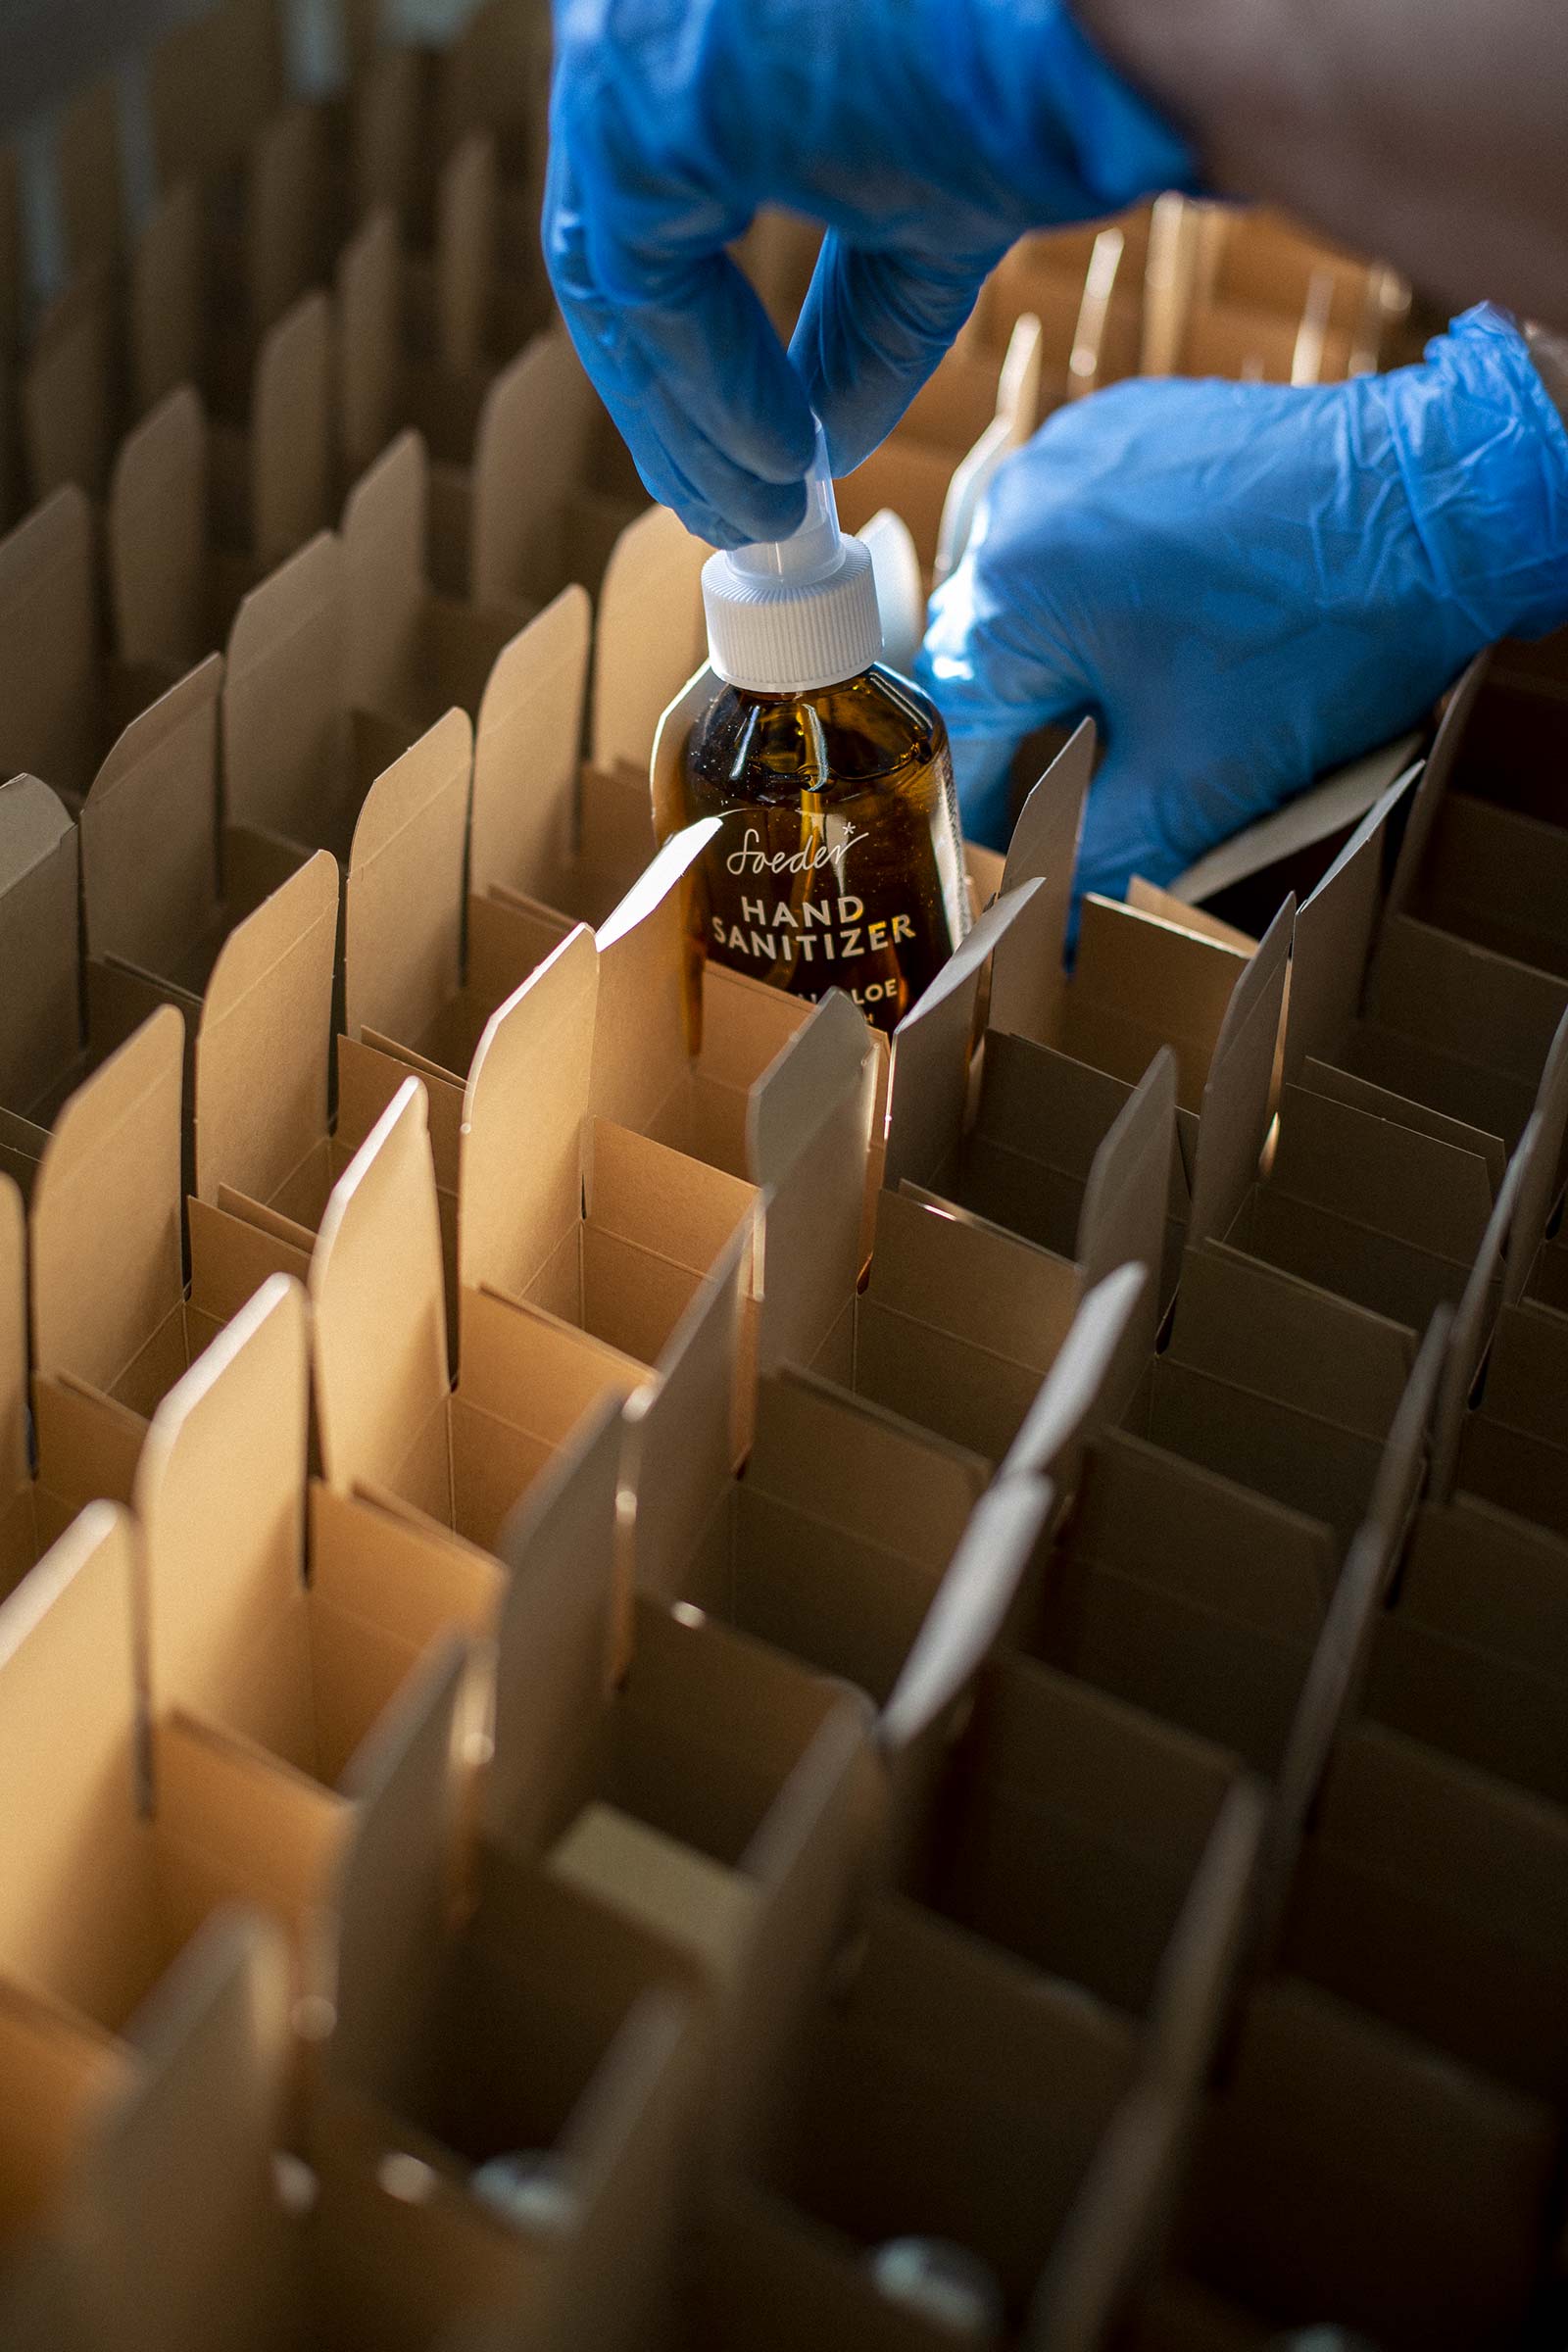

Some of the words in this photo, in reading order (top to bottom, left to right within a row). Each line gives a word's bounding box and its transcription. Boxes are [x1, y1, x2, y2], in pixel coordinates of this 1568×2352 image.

[741, 896, 864, 928] HAND
[711, 913, 916, 961] SANITIZER
[850, 978, 898, 1004] LOE
